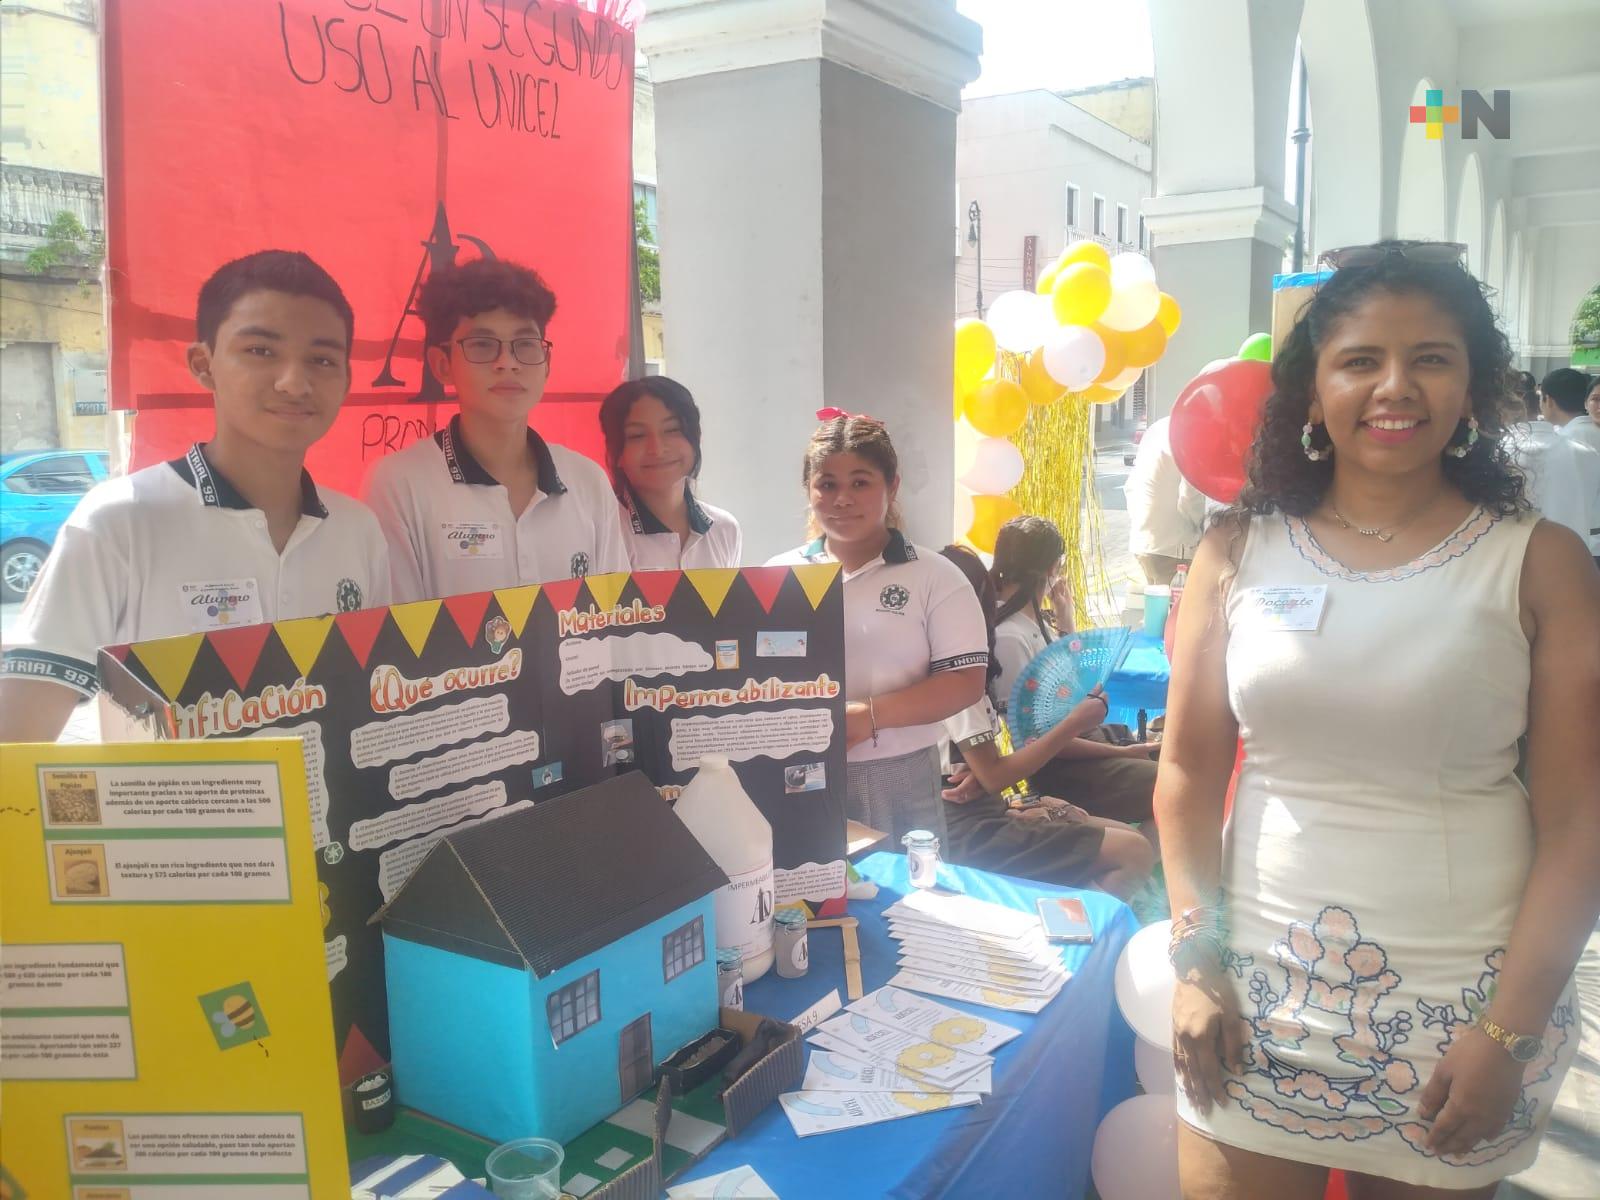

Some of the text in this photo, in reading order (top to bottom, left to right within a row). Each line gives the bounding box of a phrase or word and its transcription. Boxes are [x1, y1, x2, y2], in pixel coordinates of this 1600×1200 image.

[482, 0, 624, 90] SEGUNDO
[279, 1, 561, 139] USO AL UNICEL
[202, 485, 216, 503] 99
[447, 531, 496, 540] Alumno
[190, 594, 250, 606] Alumno
[560, 601, 665, 633] Materiales
[63, 668, 90, 686] 99
[371, 650, 522, 713] ¿Qué ocurre?
[120, 779, 146, 787] semilla
[202, 779, 244, 787] ingrediente
[109, 789, 150, 797] importante
[151, 789, 177, 797] gracias
[198, 808, 225, 816] gramos
[185, 861, 228, 870] ingrediente
[228, 862, 242, 870] que
[211, 870, 229, 878] cada
[14, 962, 56, 970] ingrediente
[57, 961, 104, 969] fundamental
[812, 1009, 818, 1022] 9
